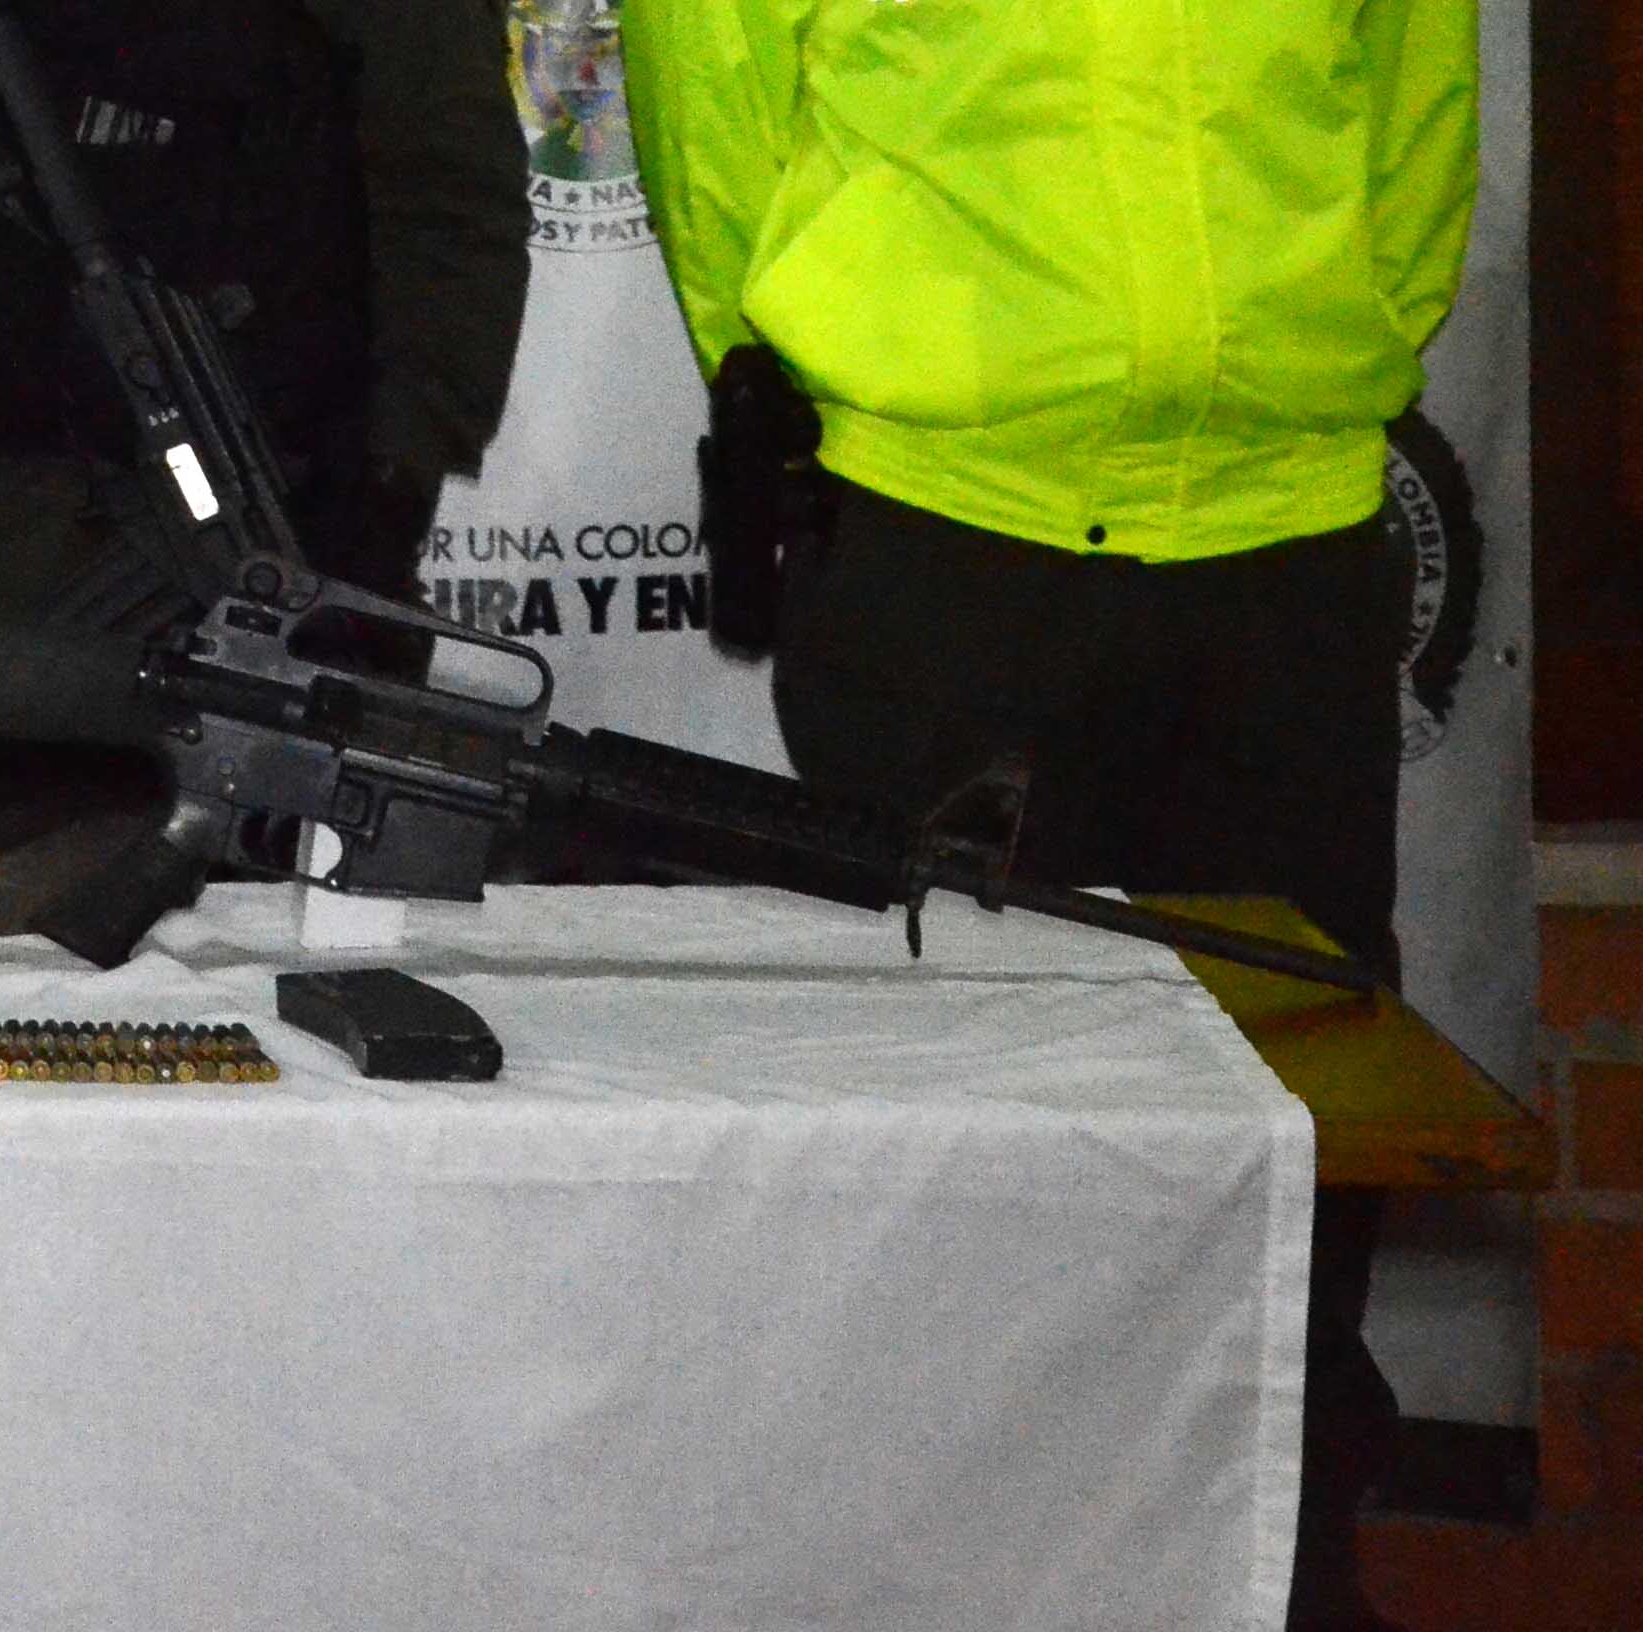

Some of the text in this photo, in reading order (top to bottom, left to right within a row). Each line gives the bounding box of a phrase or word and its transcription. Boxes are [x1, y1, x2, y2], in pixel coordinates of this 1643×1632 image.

[467, 524, 565, 562] UNA
[577, 572, 709, 634] Y EN
